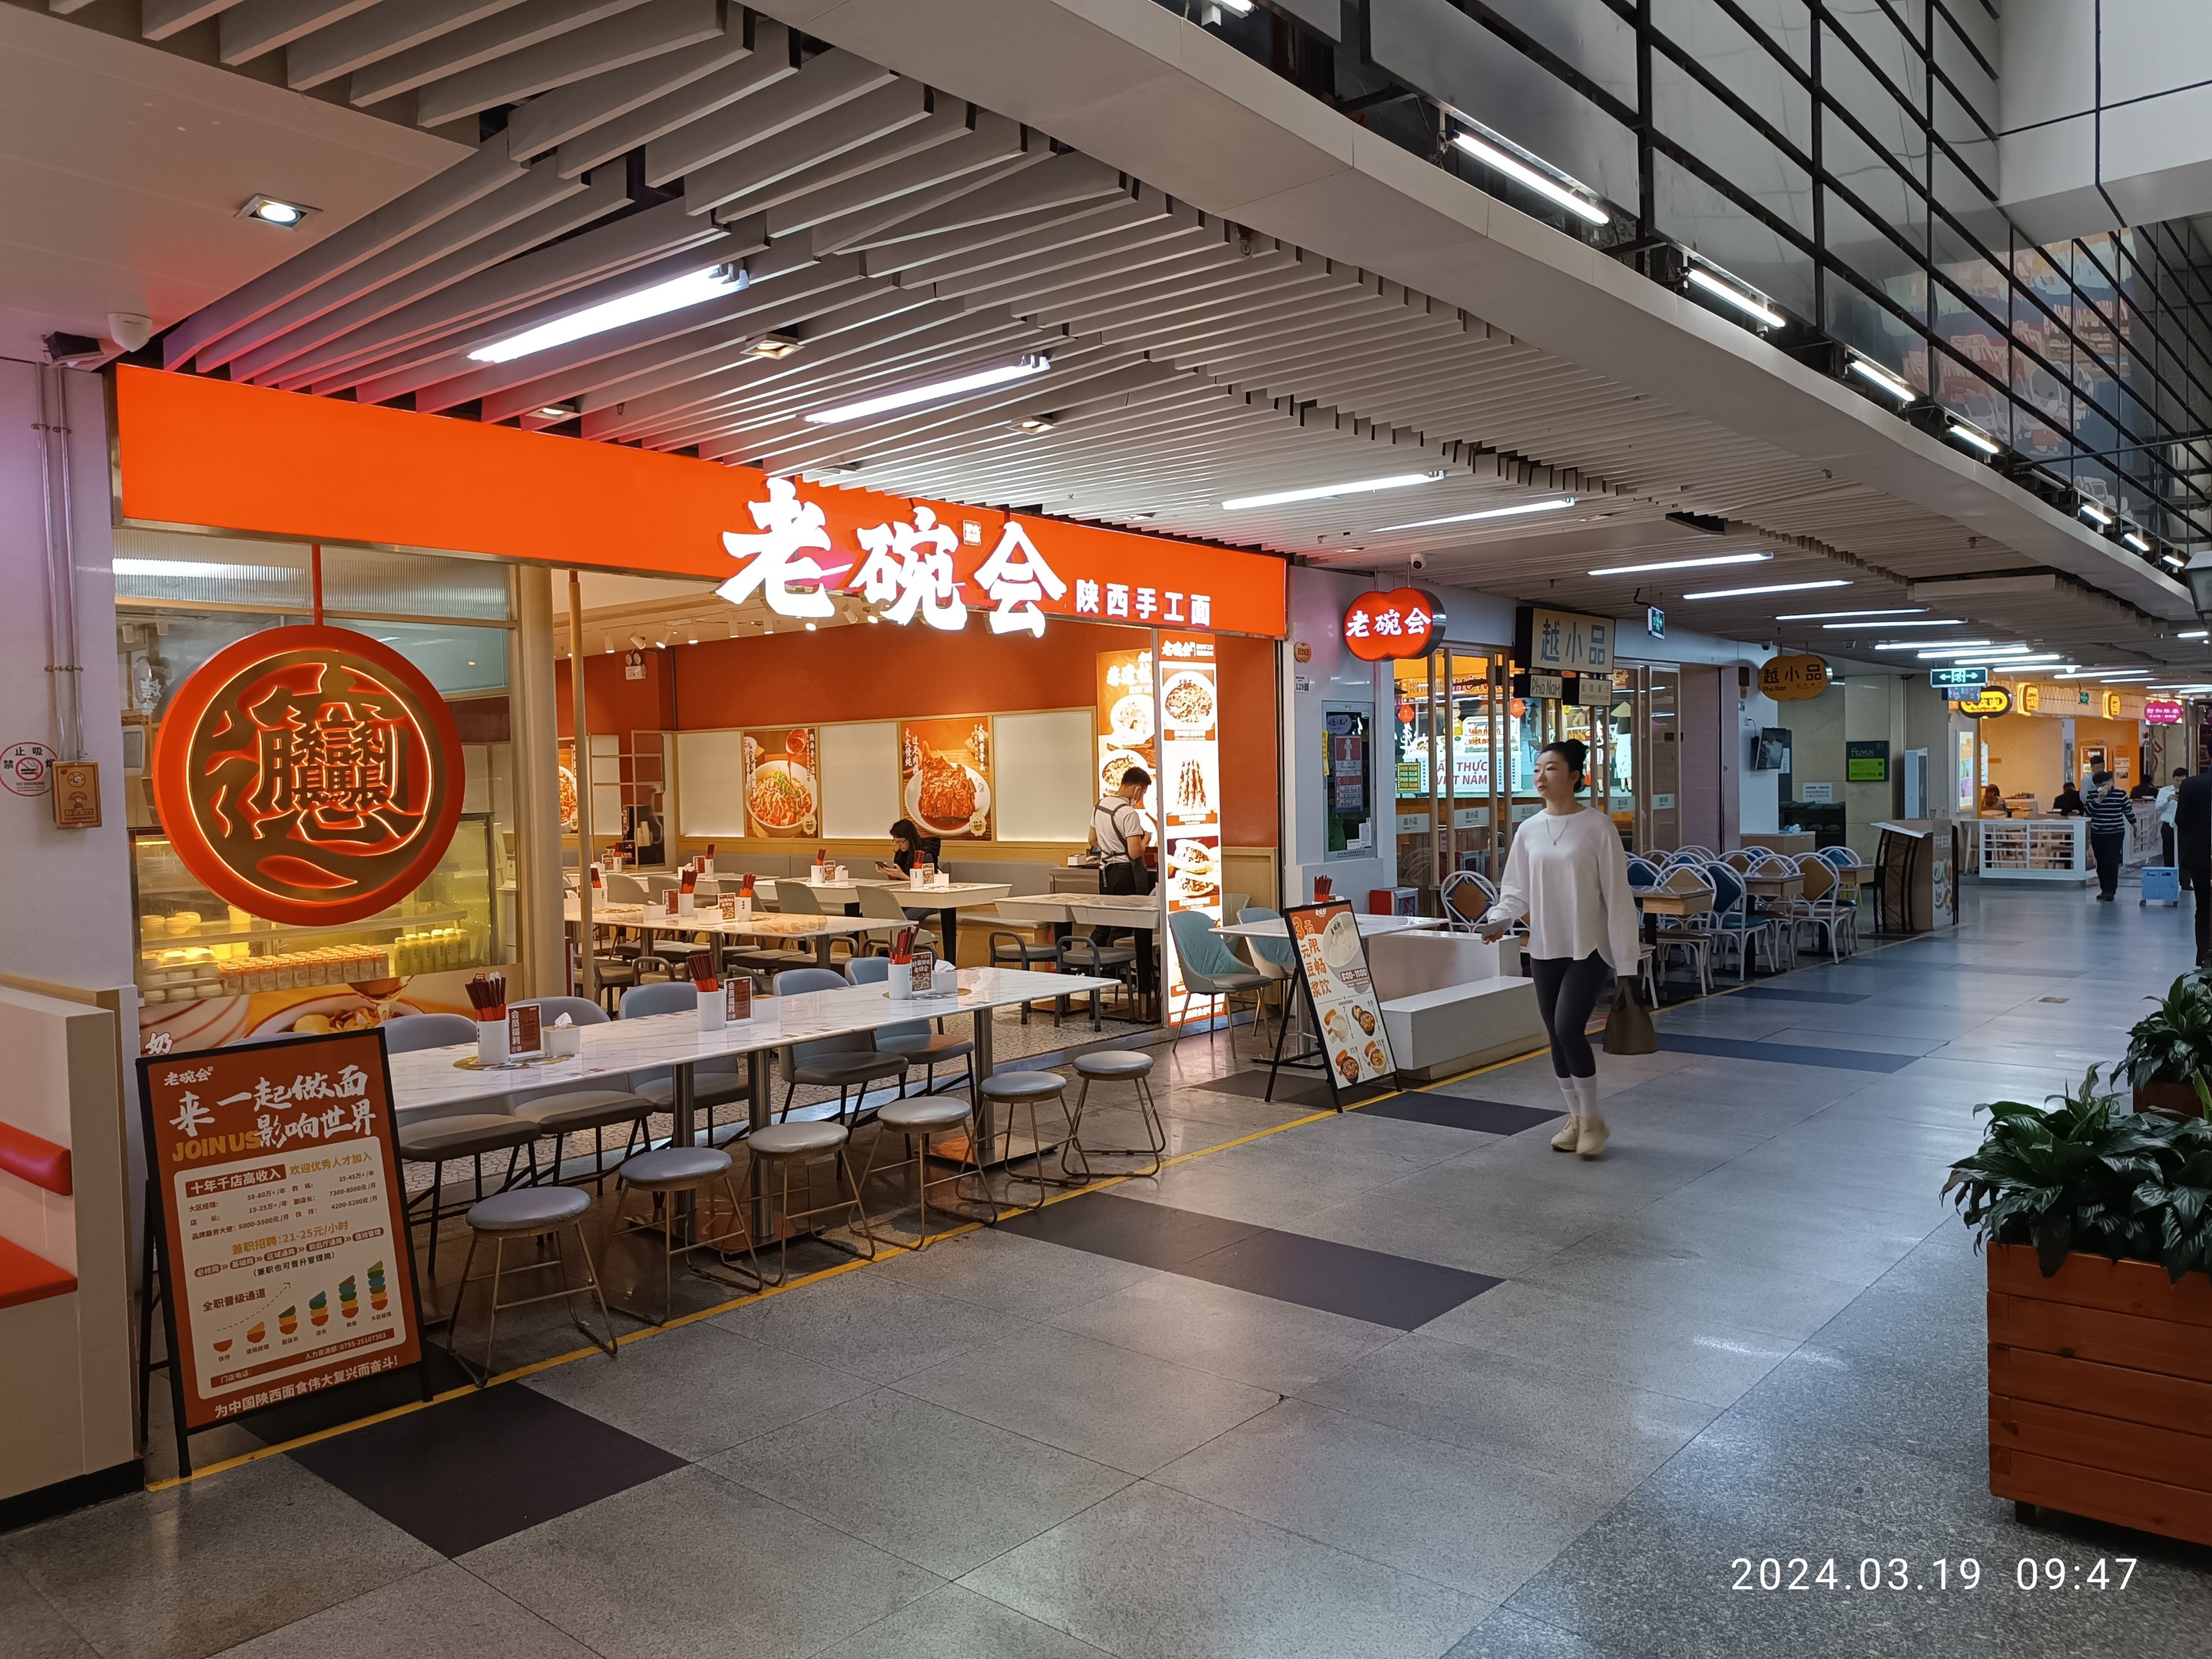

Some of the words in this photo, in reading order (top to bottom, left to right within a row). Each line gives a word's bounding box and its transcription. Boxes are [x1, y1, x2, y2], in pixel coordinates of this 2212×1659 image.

[714, 477, 1067, 638] 老碗会
[1076, 579, 1211, 627] 陕西手工面
[1346, 607, 1432, 638] 老碗会
[1541, 618, 1605, 665] 越小品
[1763, 664, 1823, 684] 越小品
[511, 1009, 521, 1045] 会员福利
[164, 1068, 212, 1086] 老碗会
[254, 1098, 376, 1148] 影响世界
[172, 1134, 227, 1162] JOIN
[227, 1130, 263, 1152] US
[289, 1152, 373, 1175] 欢迎优秀人才加入
[190, 1167, 282, 1195] 十年千店高收入
[202, 1288, 267, 1312] 全职晋级通道
